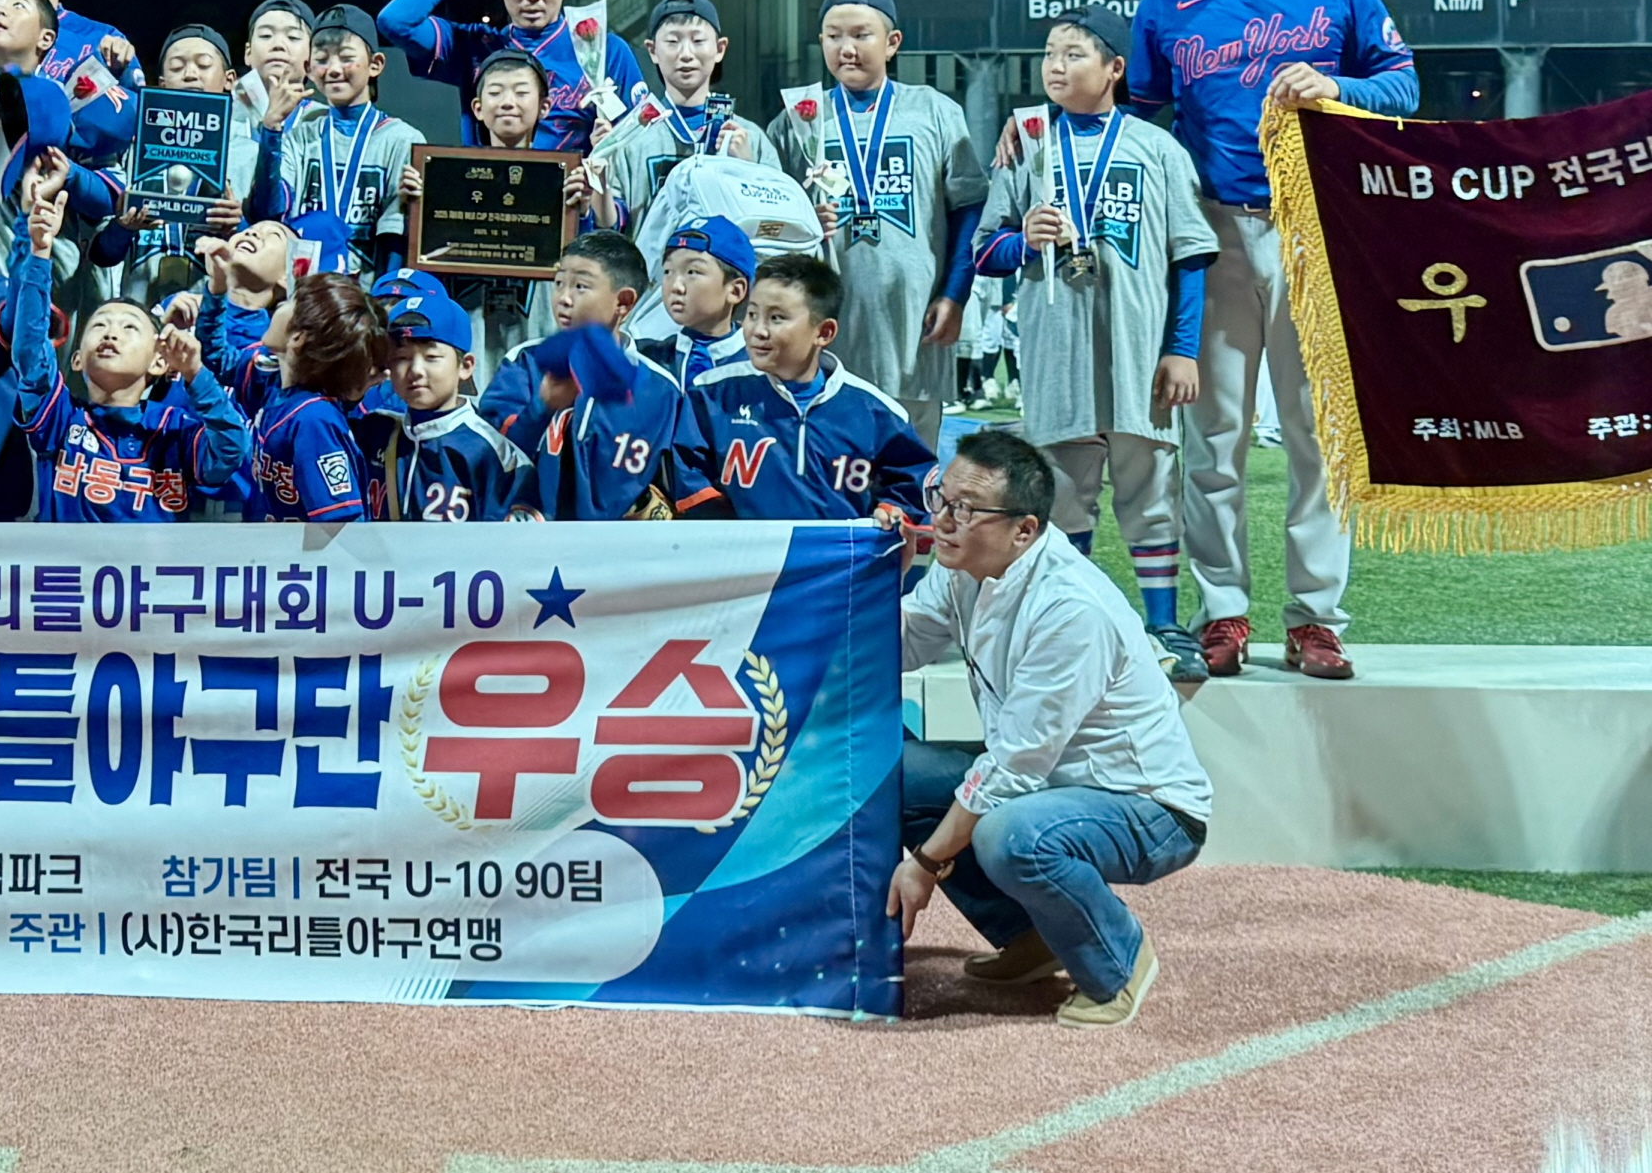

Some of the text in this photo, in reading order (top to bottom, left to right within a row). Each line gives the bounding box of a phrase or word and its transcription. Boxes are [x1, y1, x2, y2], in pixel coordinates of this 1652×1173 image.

[1173, 6, 1331, 88] New York
[160, 128, 204, 147] CUP
[176, 110, 220, 131] MLB
[149, 148, 212, 162] CHAMPIONS
[876, 175, 912, 194] 025
[1359, 163, 1434, 199] MLB
[1451, 164, 1536, 200] CUP
[158, 201, 204, 215] MLB CUP
[1396, 262, 1487, 343] 우
[612, 433, 649, 474] 13
[721, 437, 776, 488] N
[832, 455, 871, 493] 18
[53, 449, 188, 512] 남동구청
[422, 482, 471, 523] 25
[354, 570, 505, 630] U-10
[422, 639, 755, 821] 우승
[162, 855, 277, 900] 참가팀
[315, 858, 392, 900] 전국
[405, 861, 502, 899] U-10
[514, 861, 603, 903] 90팀
[9, 912, 86, 955] 주관
[120, 912, 503, 962] (사)한국리틀야구연맹
